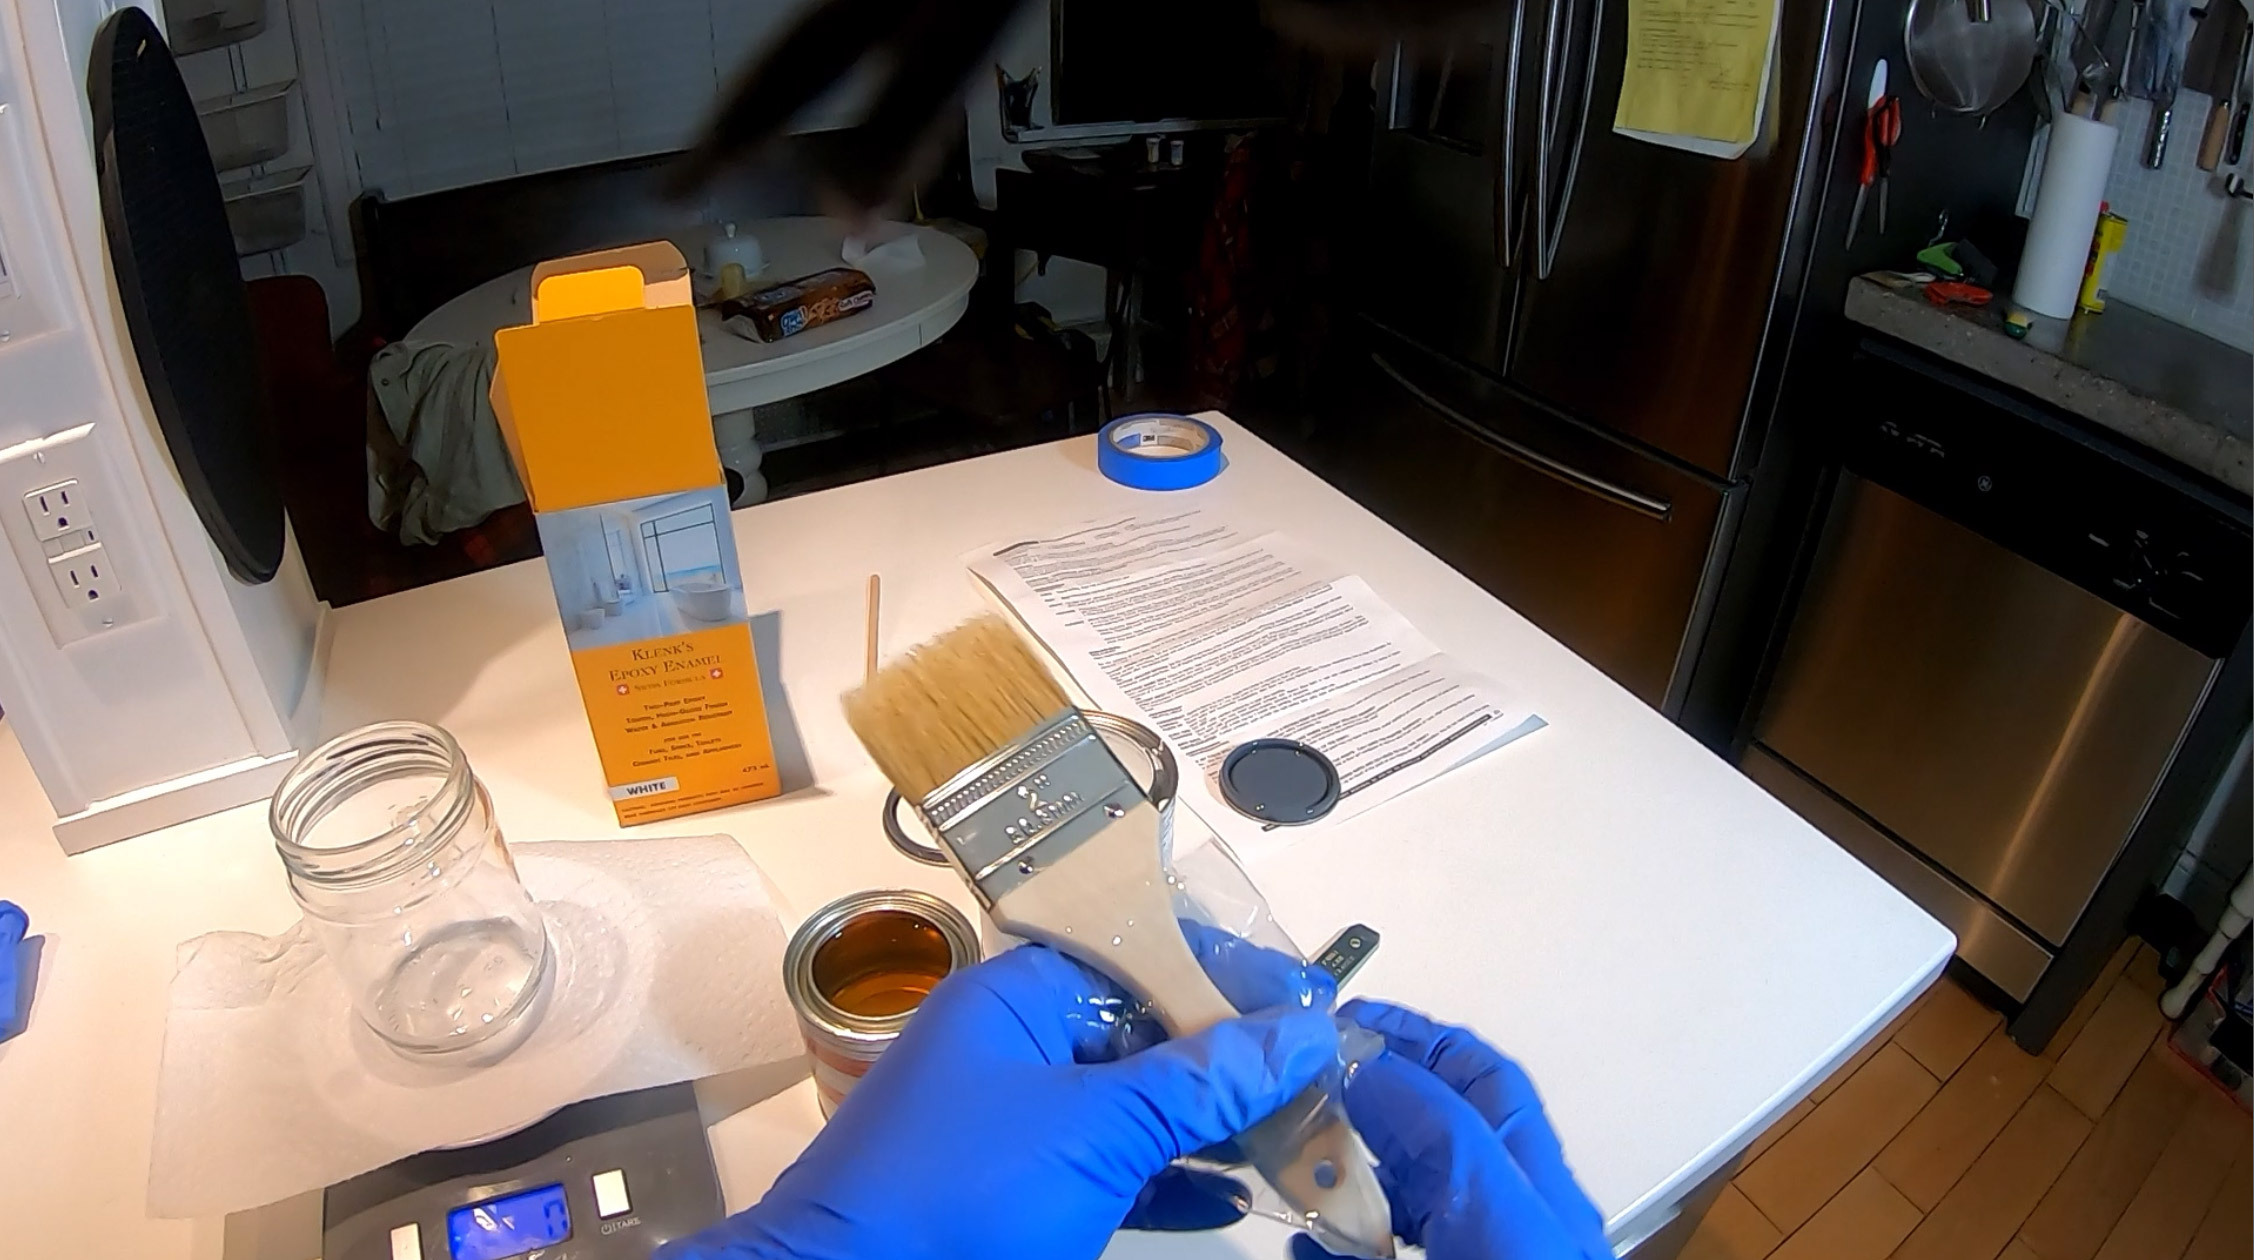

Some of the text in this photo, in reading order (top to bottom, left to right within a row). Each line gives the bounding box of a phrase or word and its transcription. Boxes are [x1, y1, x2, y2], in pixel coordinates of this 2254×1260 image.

[632, 641, 694, 661] KLENK'S
[609, 655, 721, 681] EPOXY ENAMEL
[626, 781, 667, 796] WHITE
